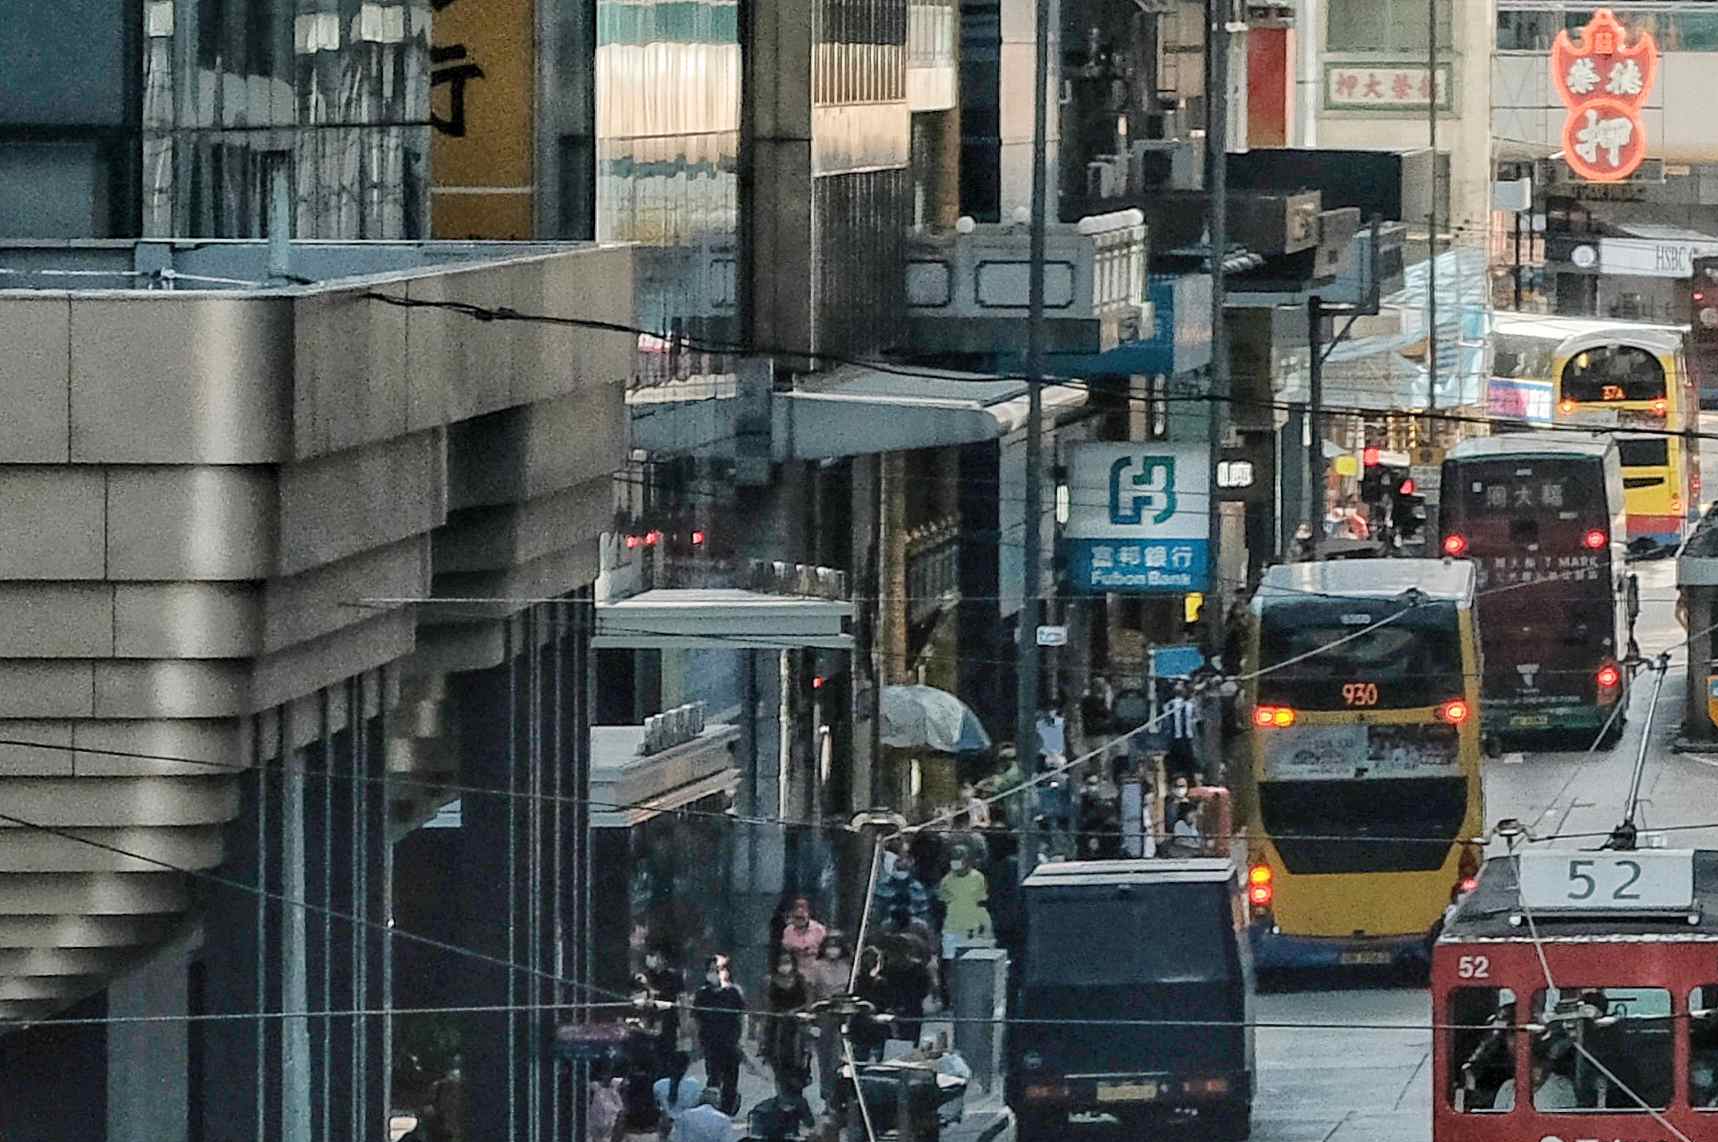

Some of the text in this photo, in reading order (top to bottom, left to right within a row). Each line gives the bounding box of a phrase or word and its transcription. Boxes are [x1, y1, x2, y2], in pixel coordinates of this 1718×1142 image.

[1575, 109, 1634, 168] 押
[1655, 244, 1687, 272] HSBC
[1091, 545, 1193, 568] 富邦銀行
[1091, 568, 1192, 585] Fubon Bank
[1342, 683, 1378, 706] 930
[1568, 860, 1643, 901] 52
[1458, 955, 1490, 980] 52
